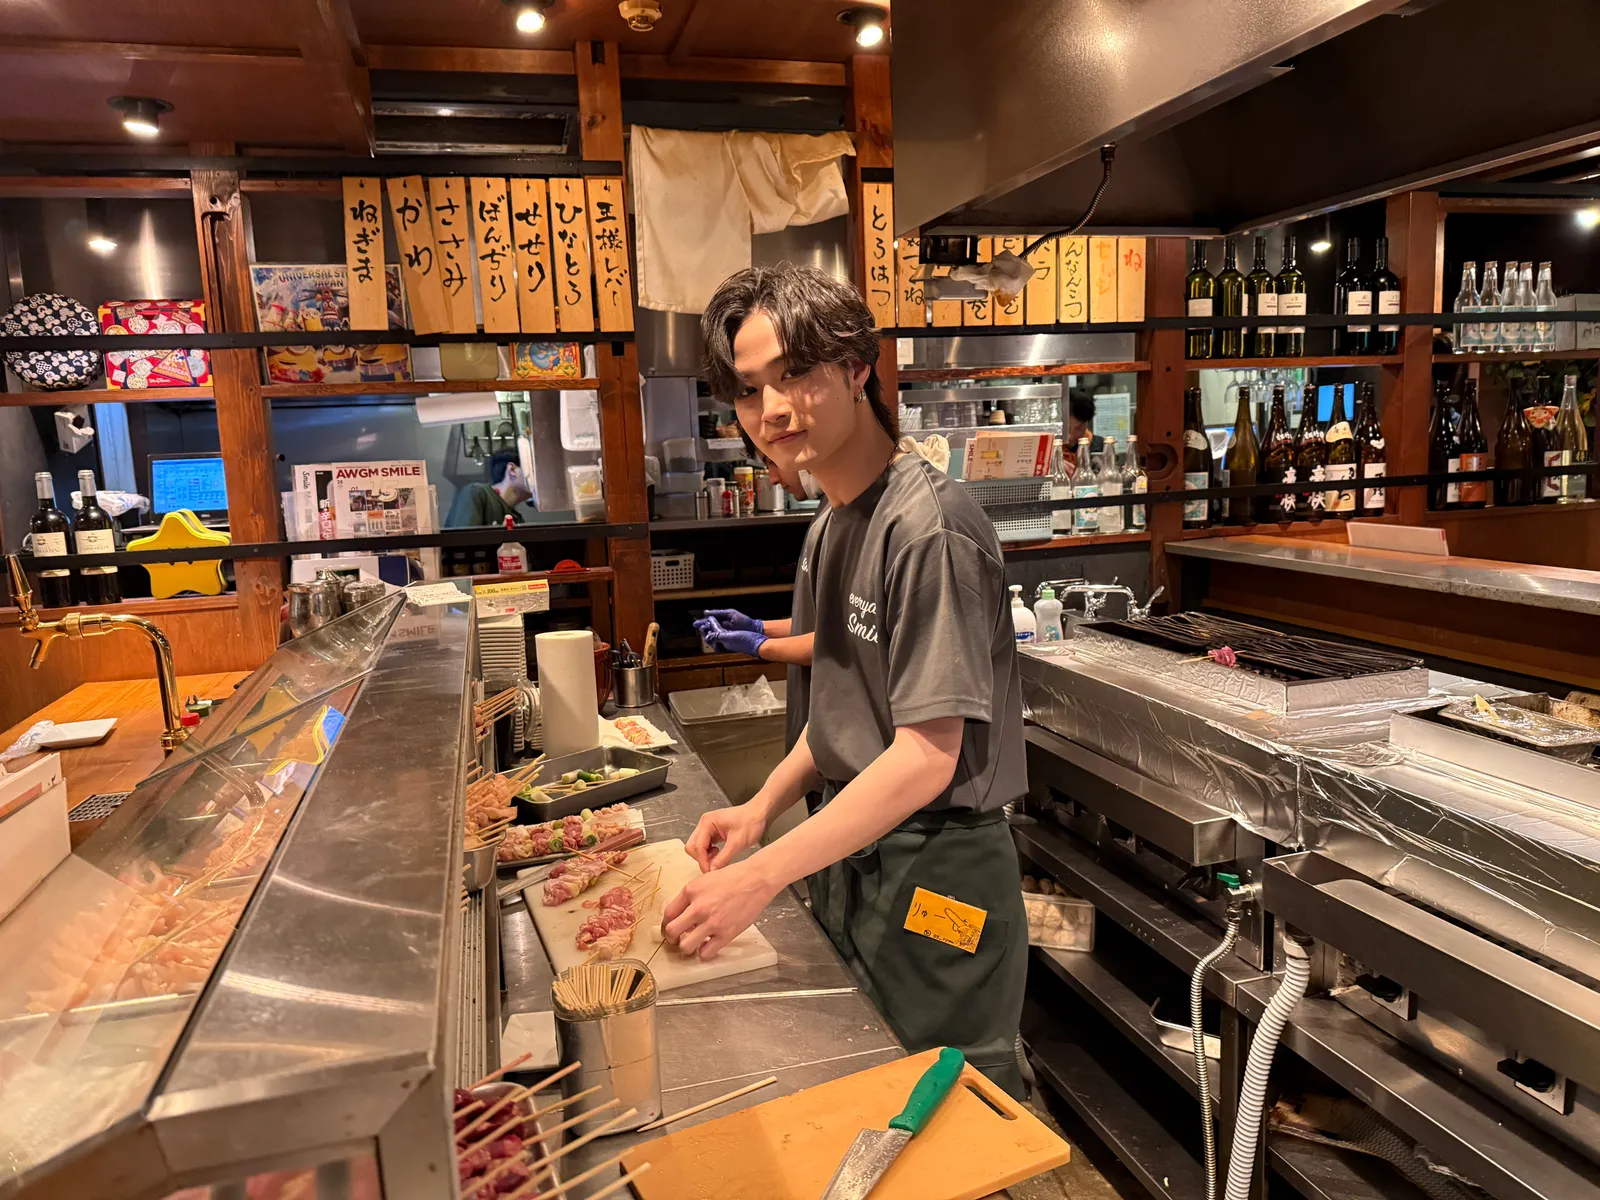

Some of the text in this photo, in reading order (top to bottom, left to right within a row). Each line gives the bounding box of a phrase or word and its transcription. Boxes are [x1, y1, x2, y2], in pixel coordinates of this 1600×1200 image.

[279, 270, 332, 283] UNIVERSAL
[350, 201, 378, 284] ねぎま
[396, 197, 433, 276] かわ
[435, 197, 468, 297] ささみ
[515, 202, 546, 293] せせり
[555, 202, 582, 306] ひなとろ
[871, 205, 891, 307] とろはつ
[314, 279, 344, 288] JAPAN
[336, 468, 379, 479] AWGM
[381, 466, 421, 477] SMILE
